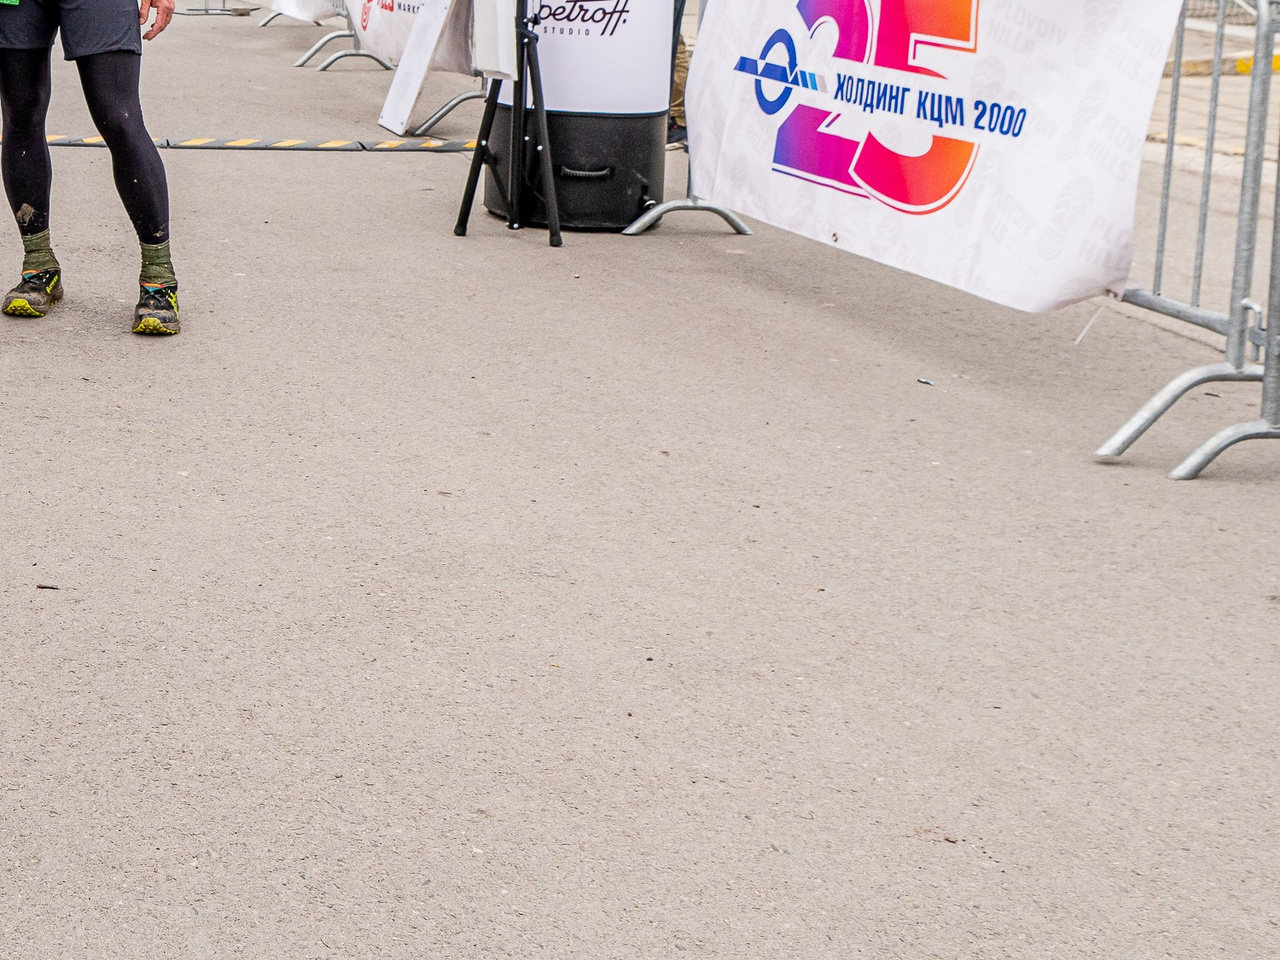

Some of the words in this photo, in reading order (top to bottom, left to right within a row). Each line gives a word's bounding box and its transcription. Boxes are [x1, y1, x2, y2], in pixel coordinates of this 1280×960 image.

[544, 26, 590, 36] STUDIO
[834, 73, 911, 116] ХОЛДИНГ
[916, 90, 964, 128] КЦМ
[974, 100, 1027, 137] 2000
